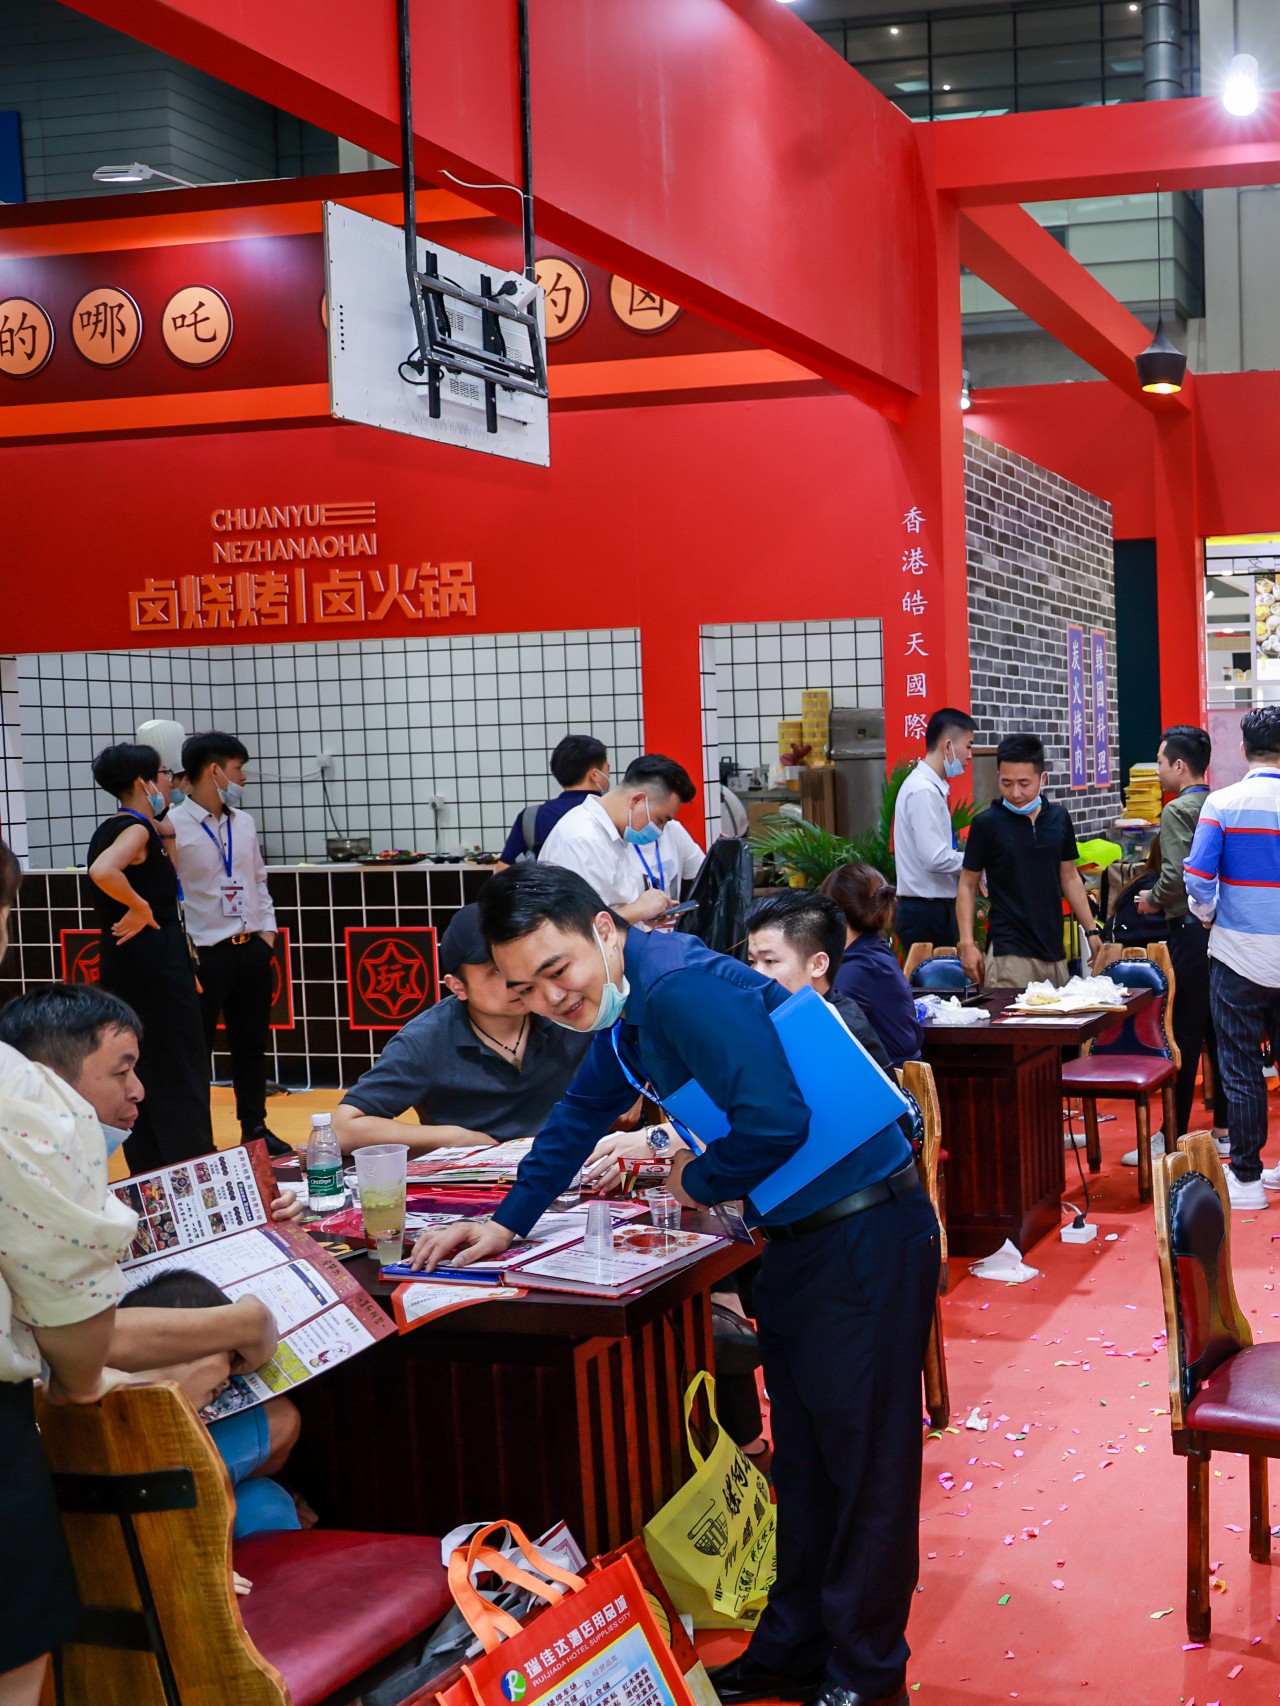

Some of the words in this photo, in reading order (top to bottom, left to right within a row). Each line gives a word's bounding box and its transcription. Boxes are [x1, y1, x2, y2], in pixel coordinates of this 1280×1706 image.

[212, 533, 378, 563] NEZHANAOHAI
[1071, 640, 1083, 775] 炭火烤肉
[1095, 644, 1107, 775] 韓國料理
[377, 964, 411, 993] 玩
[523, 1594, 628, 1679] 瑞佳达酒店用品城
[532, 1660, 567, 1687] RUIJIADA
[566, 1644, 590, 1663] HOTEL
[589, 1622, 619, 1647] SUPPLIES
[618, 1611, 632, 1625] CITY
